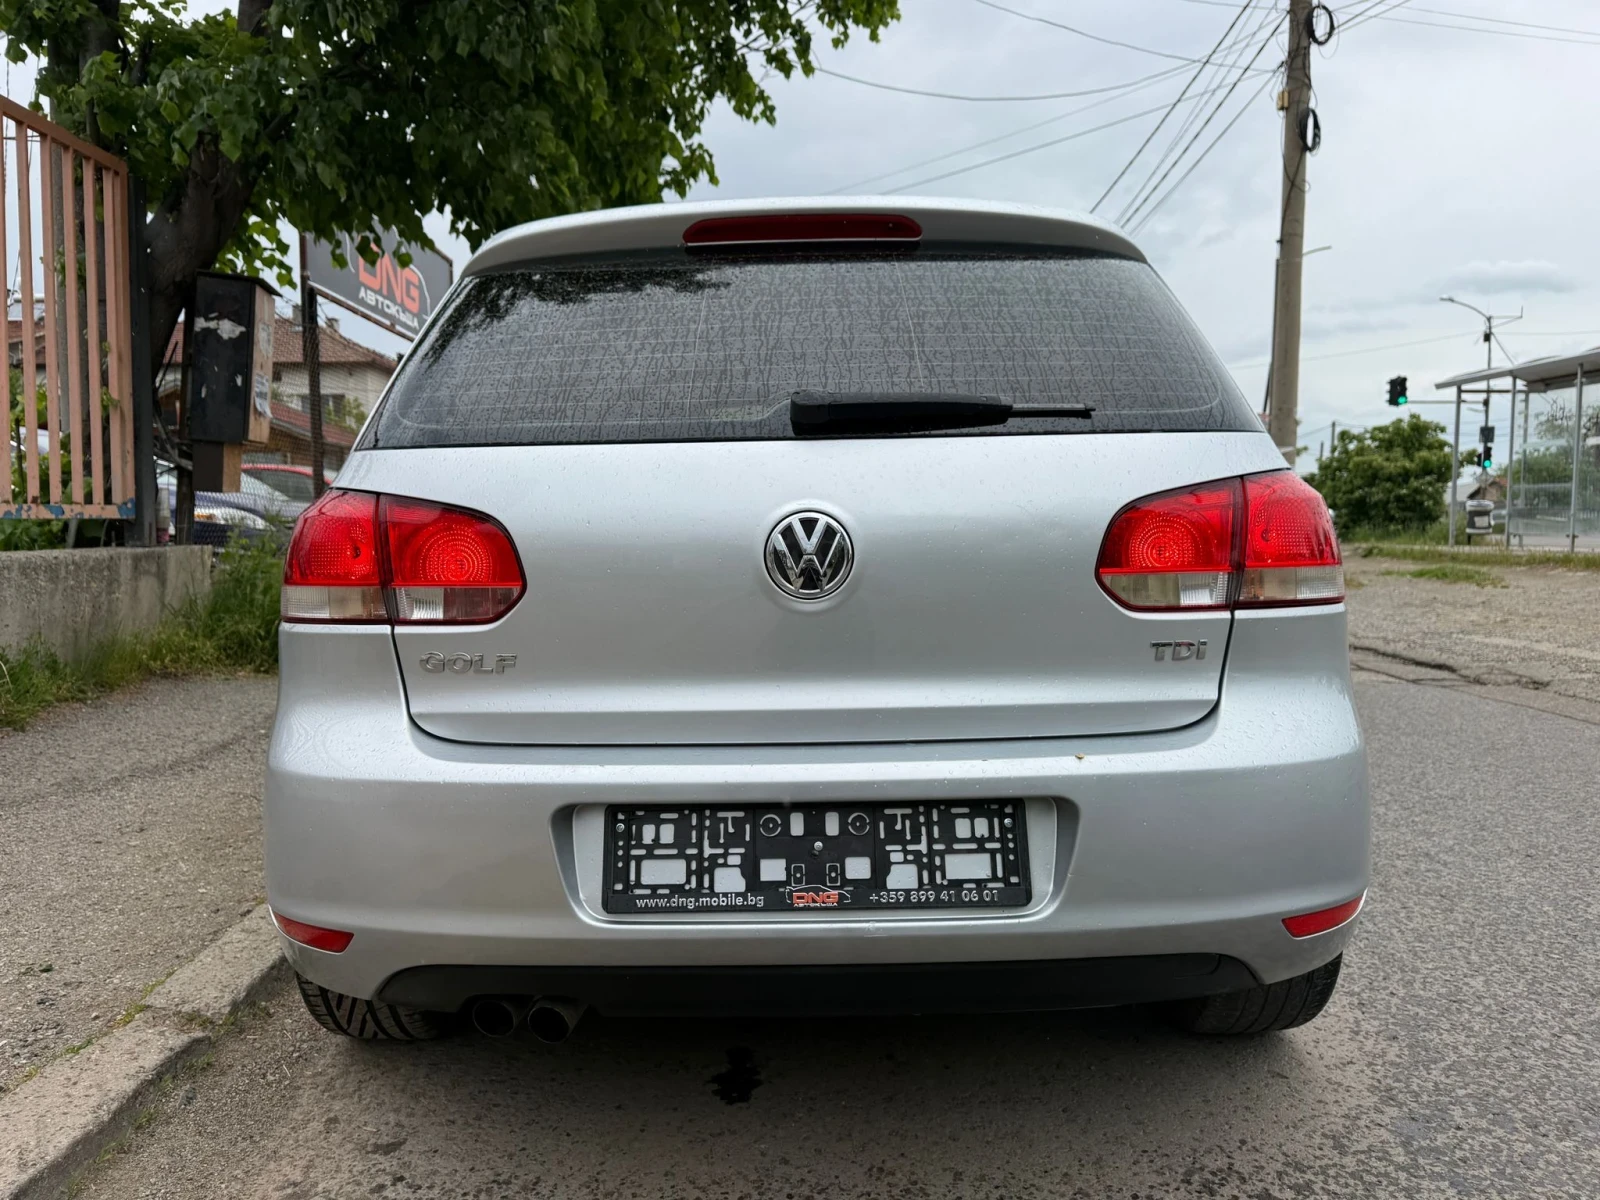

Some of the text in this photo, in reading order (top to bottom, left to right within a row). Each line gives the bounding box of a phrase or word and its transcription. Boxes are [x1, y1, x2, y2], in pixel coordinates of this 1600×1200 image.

[419, 651, 518, 674] GOLF
[635, 893, 765, 909] www.dng.mobile.bg
[792, 891, 839, 904] DNG
[869, 890, 999, 903] +359 899 41 06 01
